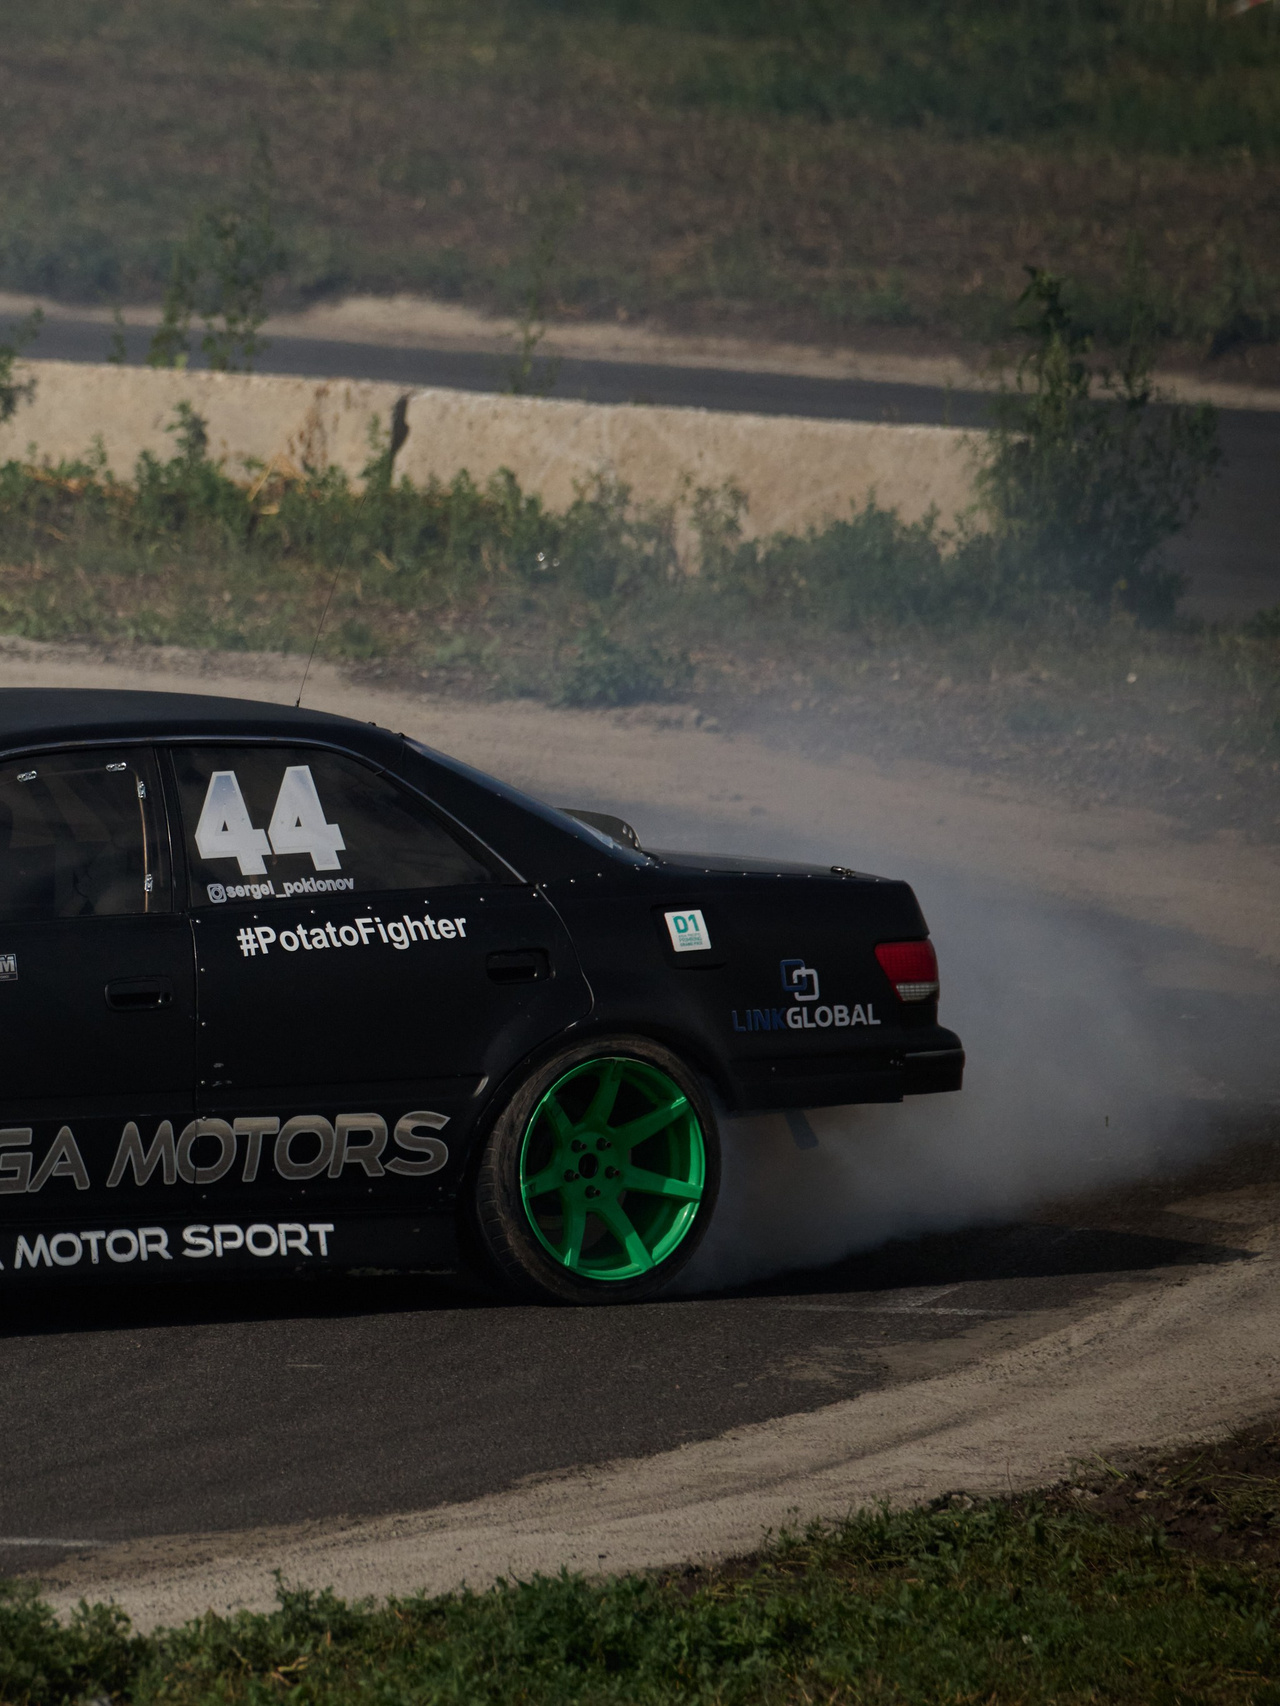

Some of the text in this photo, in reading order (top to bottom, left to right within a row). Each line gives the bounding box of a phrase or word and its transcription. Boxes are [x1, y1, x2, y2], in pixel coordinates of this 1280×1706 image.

[195, 765, 347, 876] 44
[237, 914, 467, 957] #PotatoFighter
[672, 914, 700, 934] D1
[731, 1003, 882, 1032] LINKGLOBAL
[105, 1110, 452, 1188] MOTORS
[13, 1226, 173, 1270] MOTOR
[181, 1223, 335, 1258] SPORT
